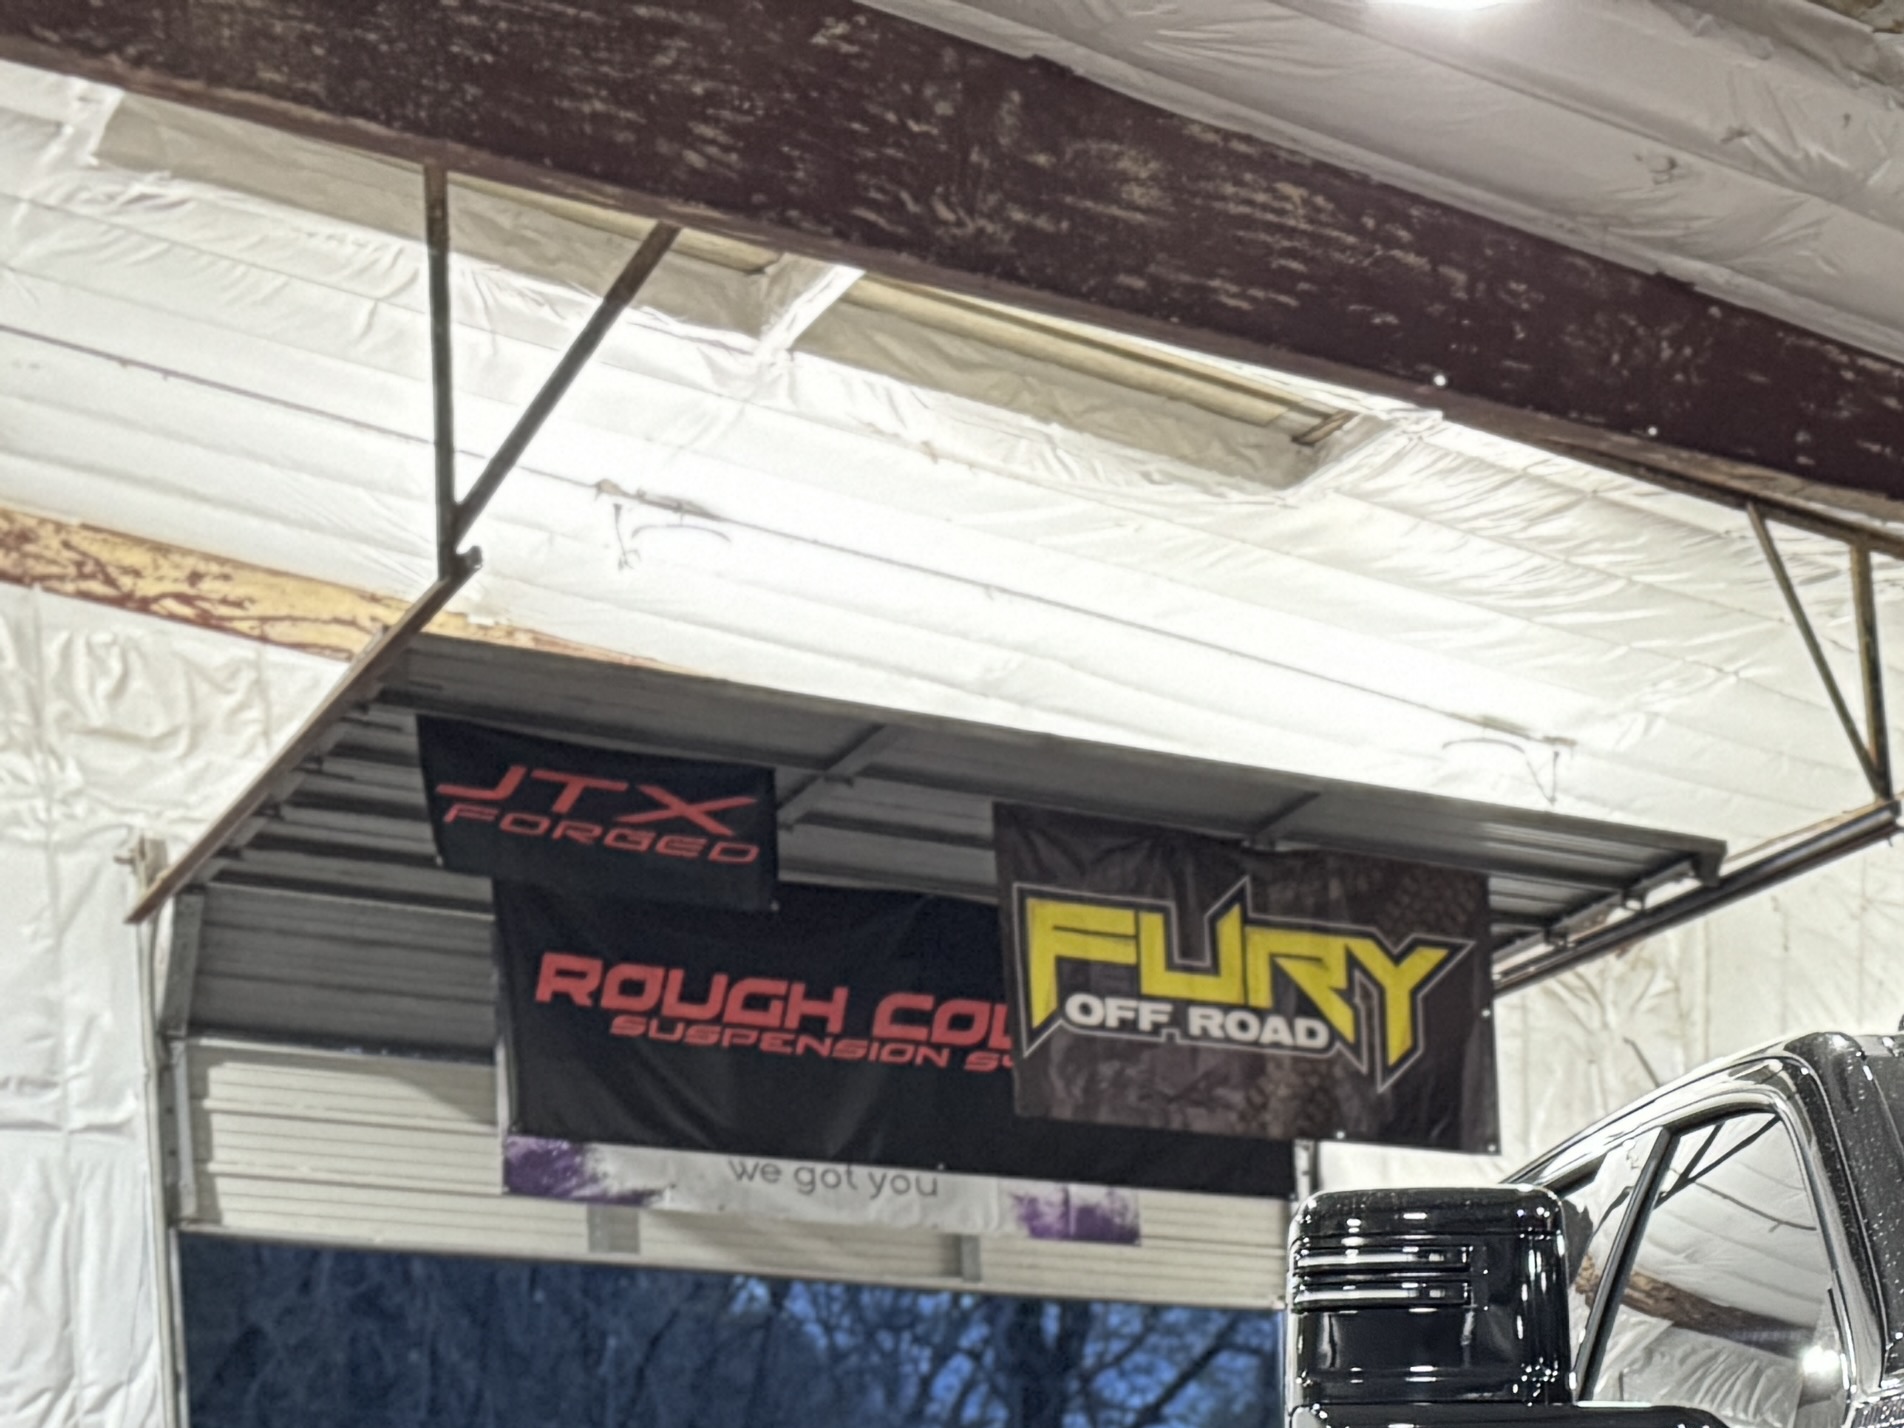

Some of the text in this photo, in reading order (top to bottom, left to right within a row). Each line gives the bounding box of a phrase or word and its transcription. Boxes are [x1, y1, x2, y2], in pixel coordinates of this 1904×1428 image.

[436, 764, 758, 837] JTX
[443, 803, 760, 864] FORGED
[535, 952, 849, 1035] ROUGH
[1024, 897, 1450, 1068] FURY
[610, 1015, 949, 1068] SUSPENSION
[1064, 992, 1330, 1049] OFF ROAD
[728, 1159, 782, 1184] we
[868, 1171, 938, 1199] you
